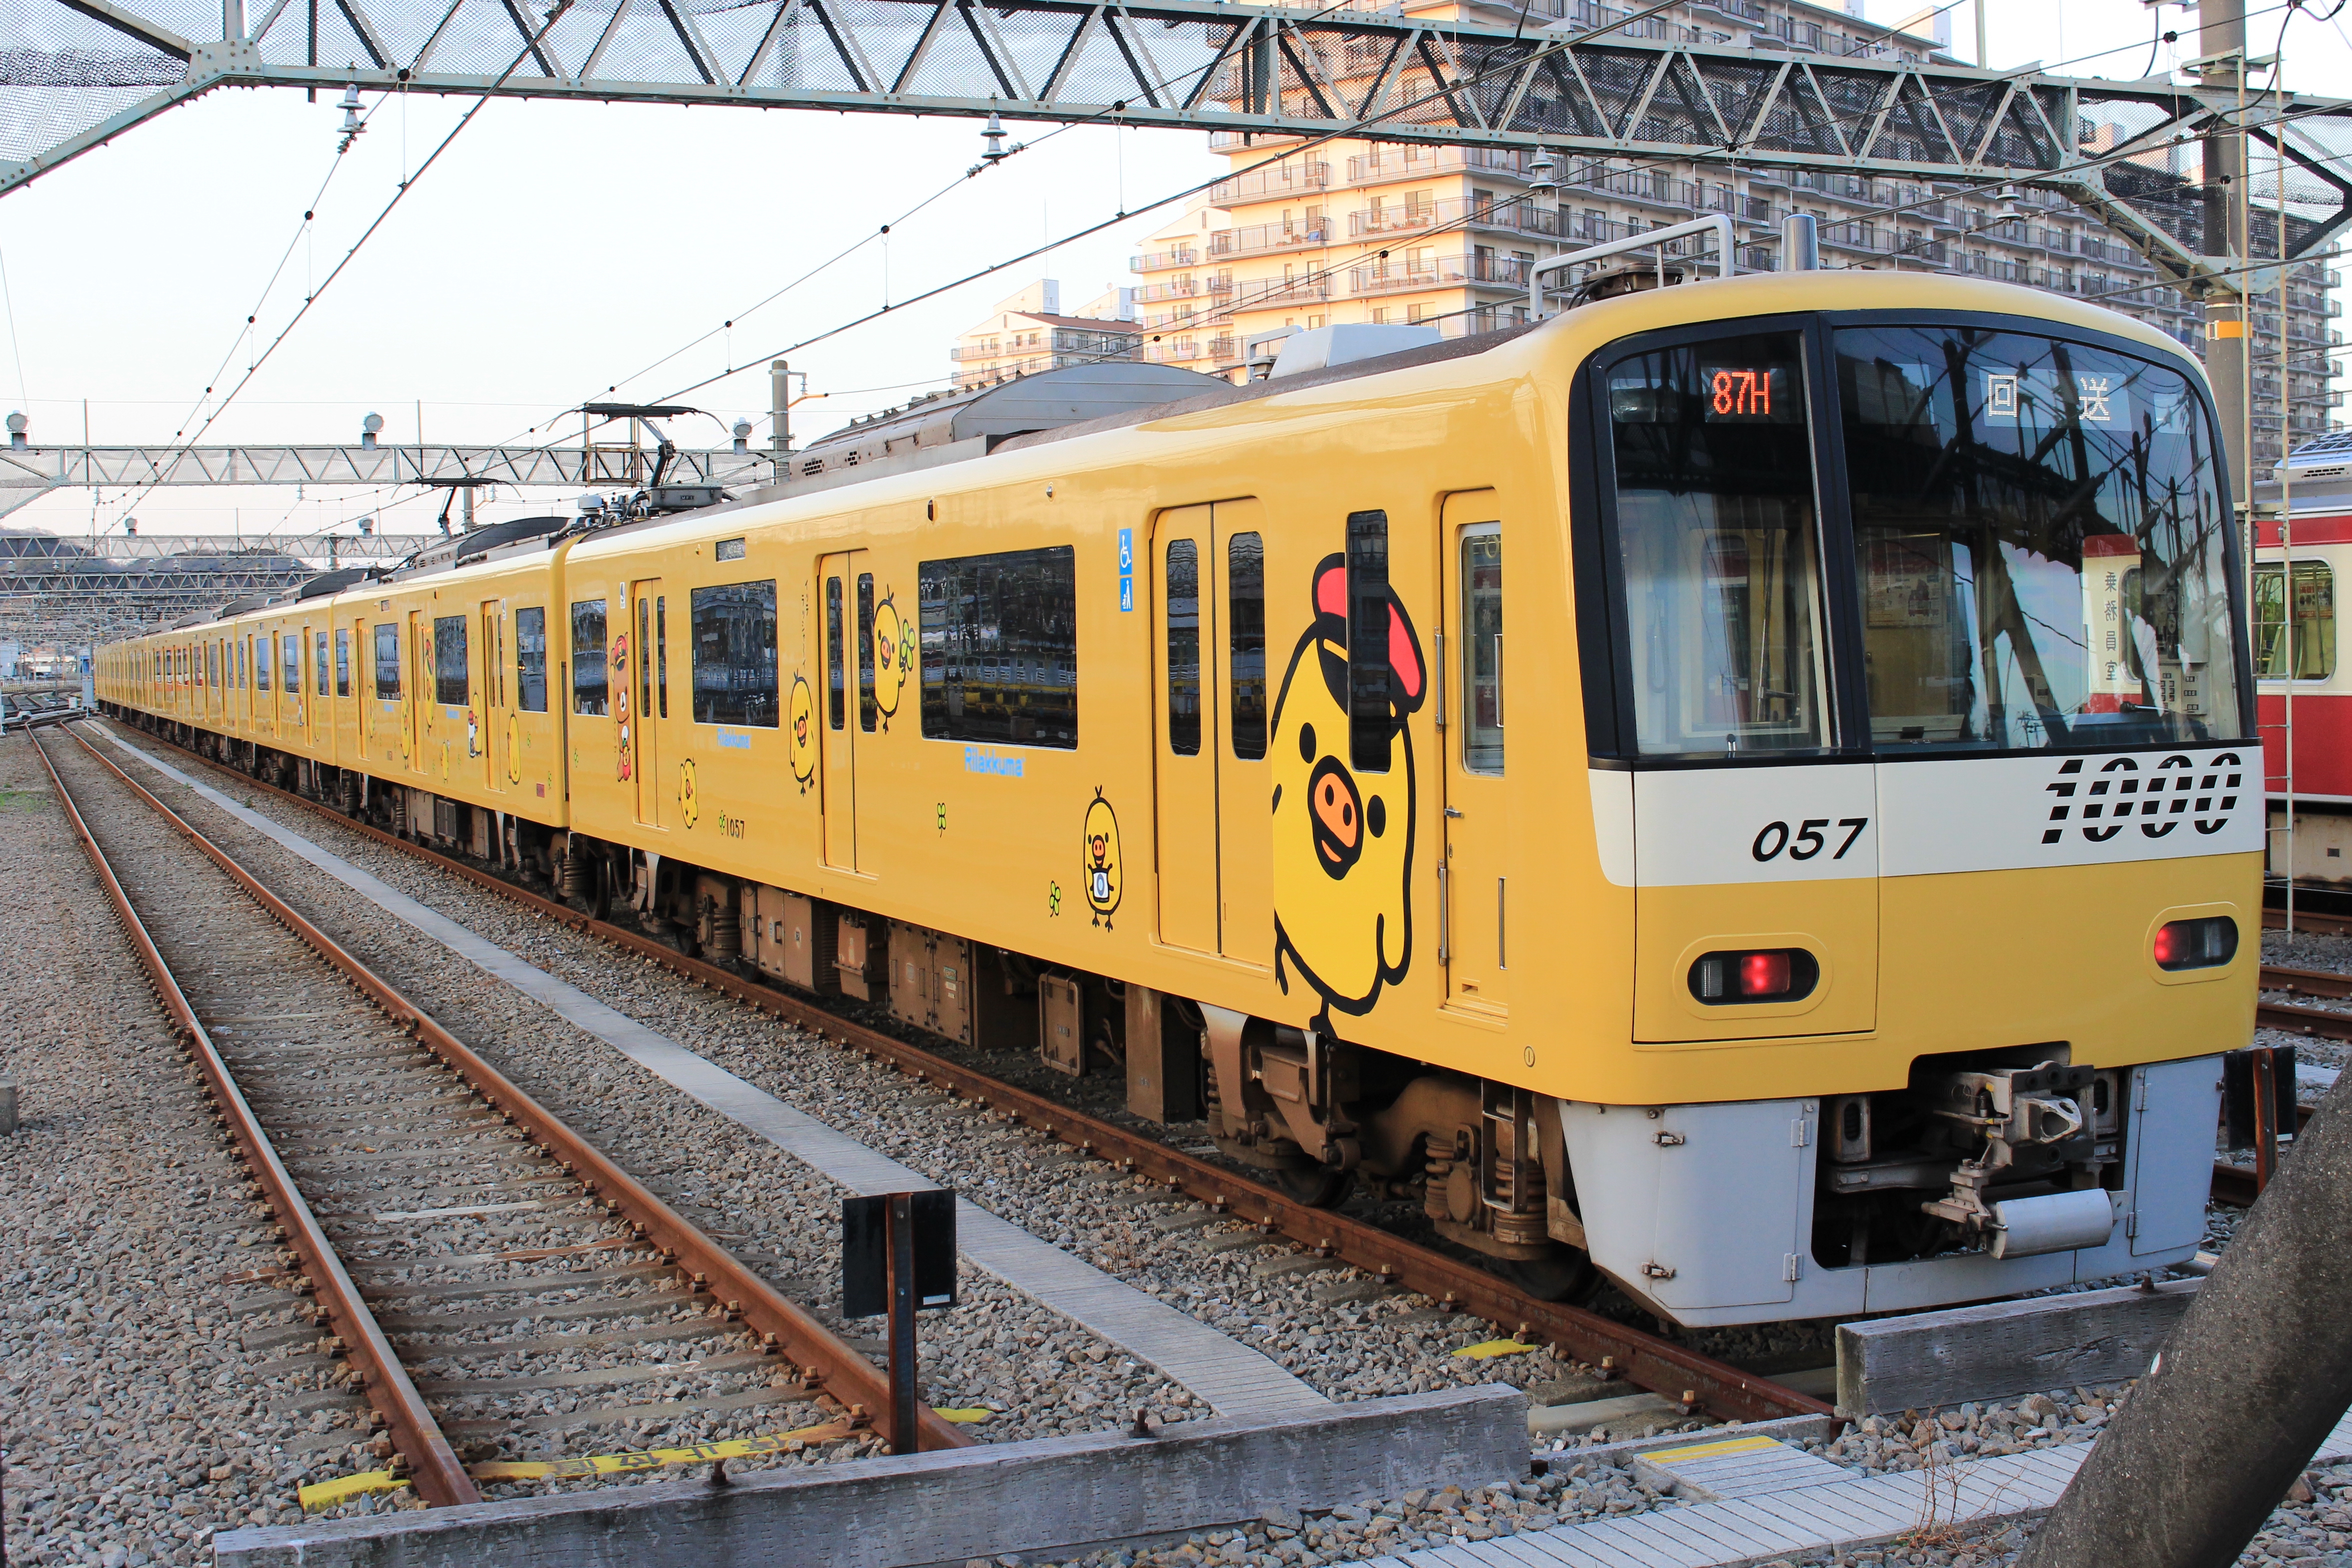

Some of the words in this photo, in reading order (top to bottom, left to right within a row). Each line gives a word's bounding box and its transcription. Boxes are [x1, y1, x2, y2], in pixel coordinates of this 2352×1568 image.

[1713, 372, 1770, 414] 87H
[1988, 374, 2110, 420] 回送
[964, 746, 1024, 778] Rilakkuma
[2041, 752, 2242, 844] 1000
[726, 818, 744, 840] 1057
[1752, 818, 1868, 862] 057
[547, 1434, 786, 1476] 停止位置
